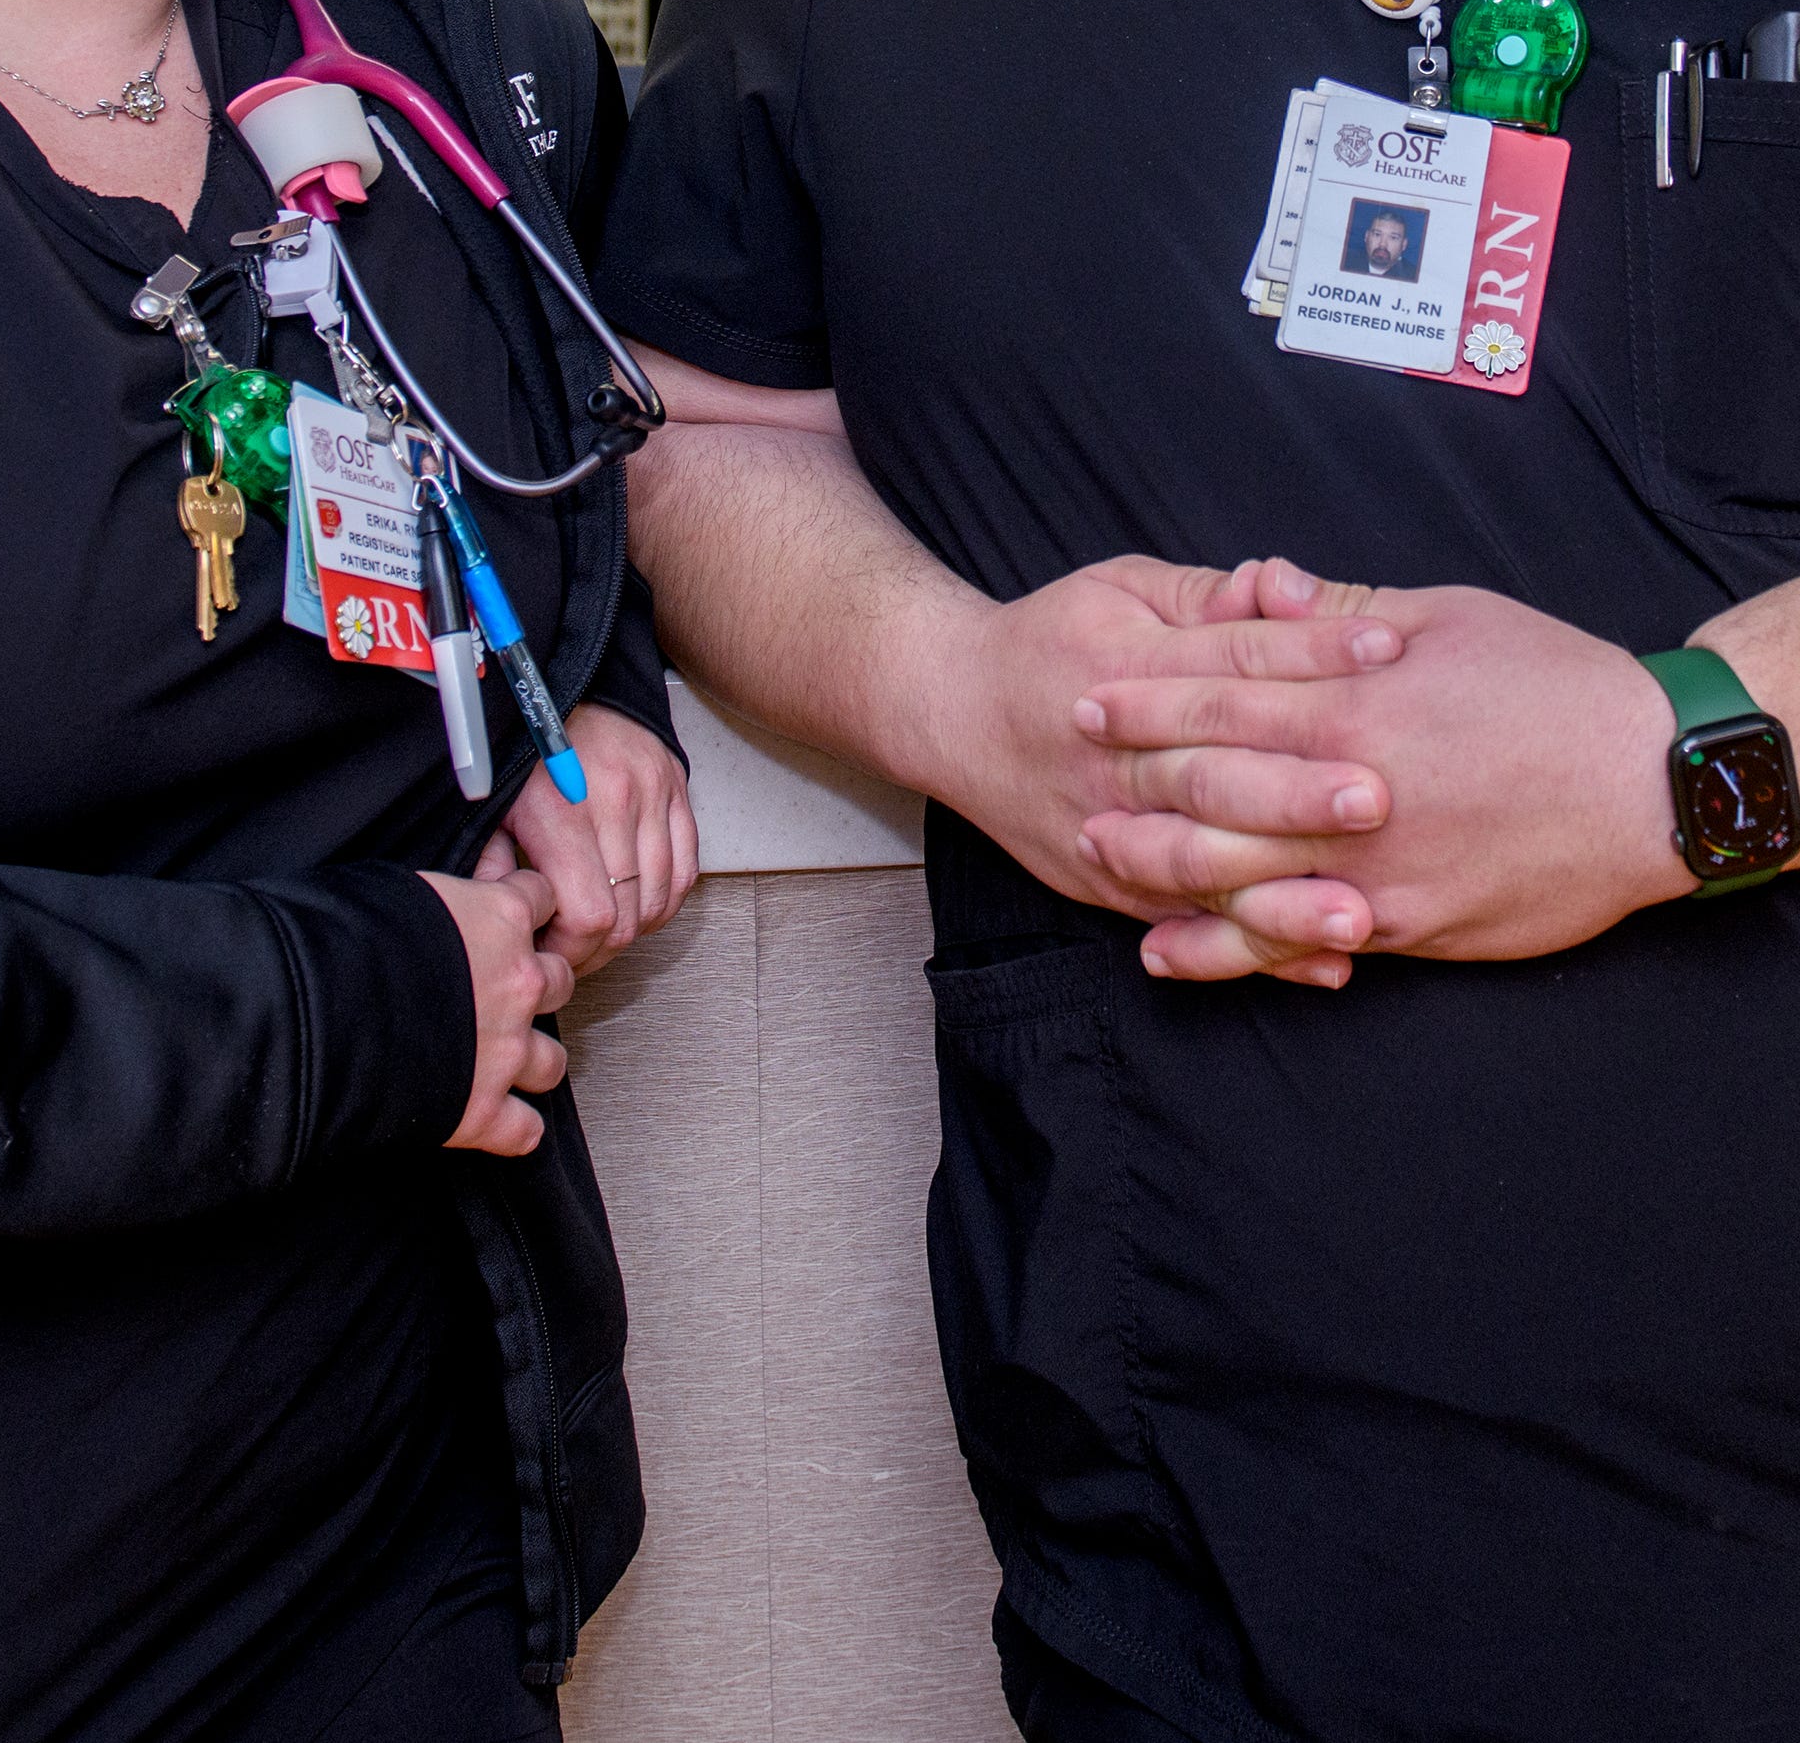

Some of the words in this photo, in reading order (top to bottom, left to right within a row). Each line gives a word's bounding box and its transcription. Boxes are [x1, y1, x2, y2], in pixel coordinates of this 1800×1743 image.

[1377, 131, 1443, 165] OSF
[1473, 201, 1540, 318] RN
[1307, 283, 1382, 308] JORDAN
[1417, 301, 1442, 318] RN
[1297, 305, 1392, 331] REGISTERED
[1395, 321, 1446, 341] NURSE
[336, 434, 374, 470] OSF
[348, 531, 409, 558] REGISTERED
[340, 552, 381, 573] PATIENT
[383, 563, 409, 581] CARE
[515, 679, 542, 729] Designs
